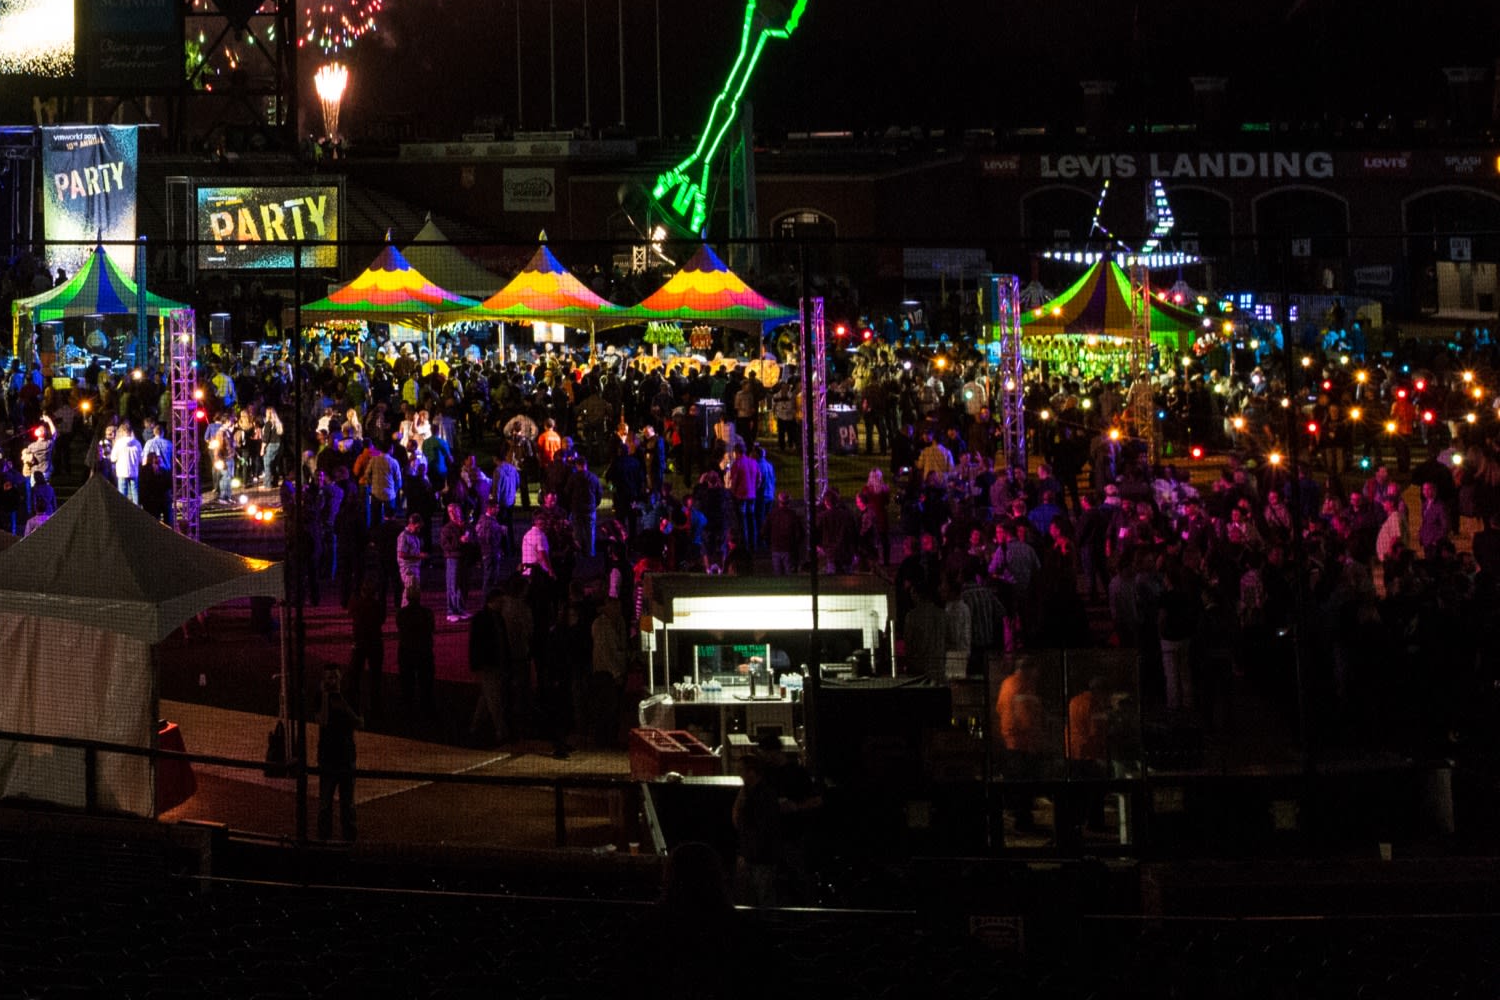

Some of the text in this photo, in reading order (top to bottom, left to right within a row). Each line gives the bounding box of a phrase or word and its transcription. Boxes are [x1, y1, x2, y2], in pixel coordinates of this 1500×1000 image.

[53, 133, 83, 141] vmworld
[54, 161, 124, 201] PARTY
[1150, 152, 1335, 178] LANDING
[210, 195, 327, 253] PARTY
